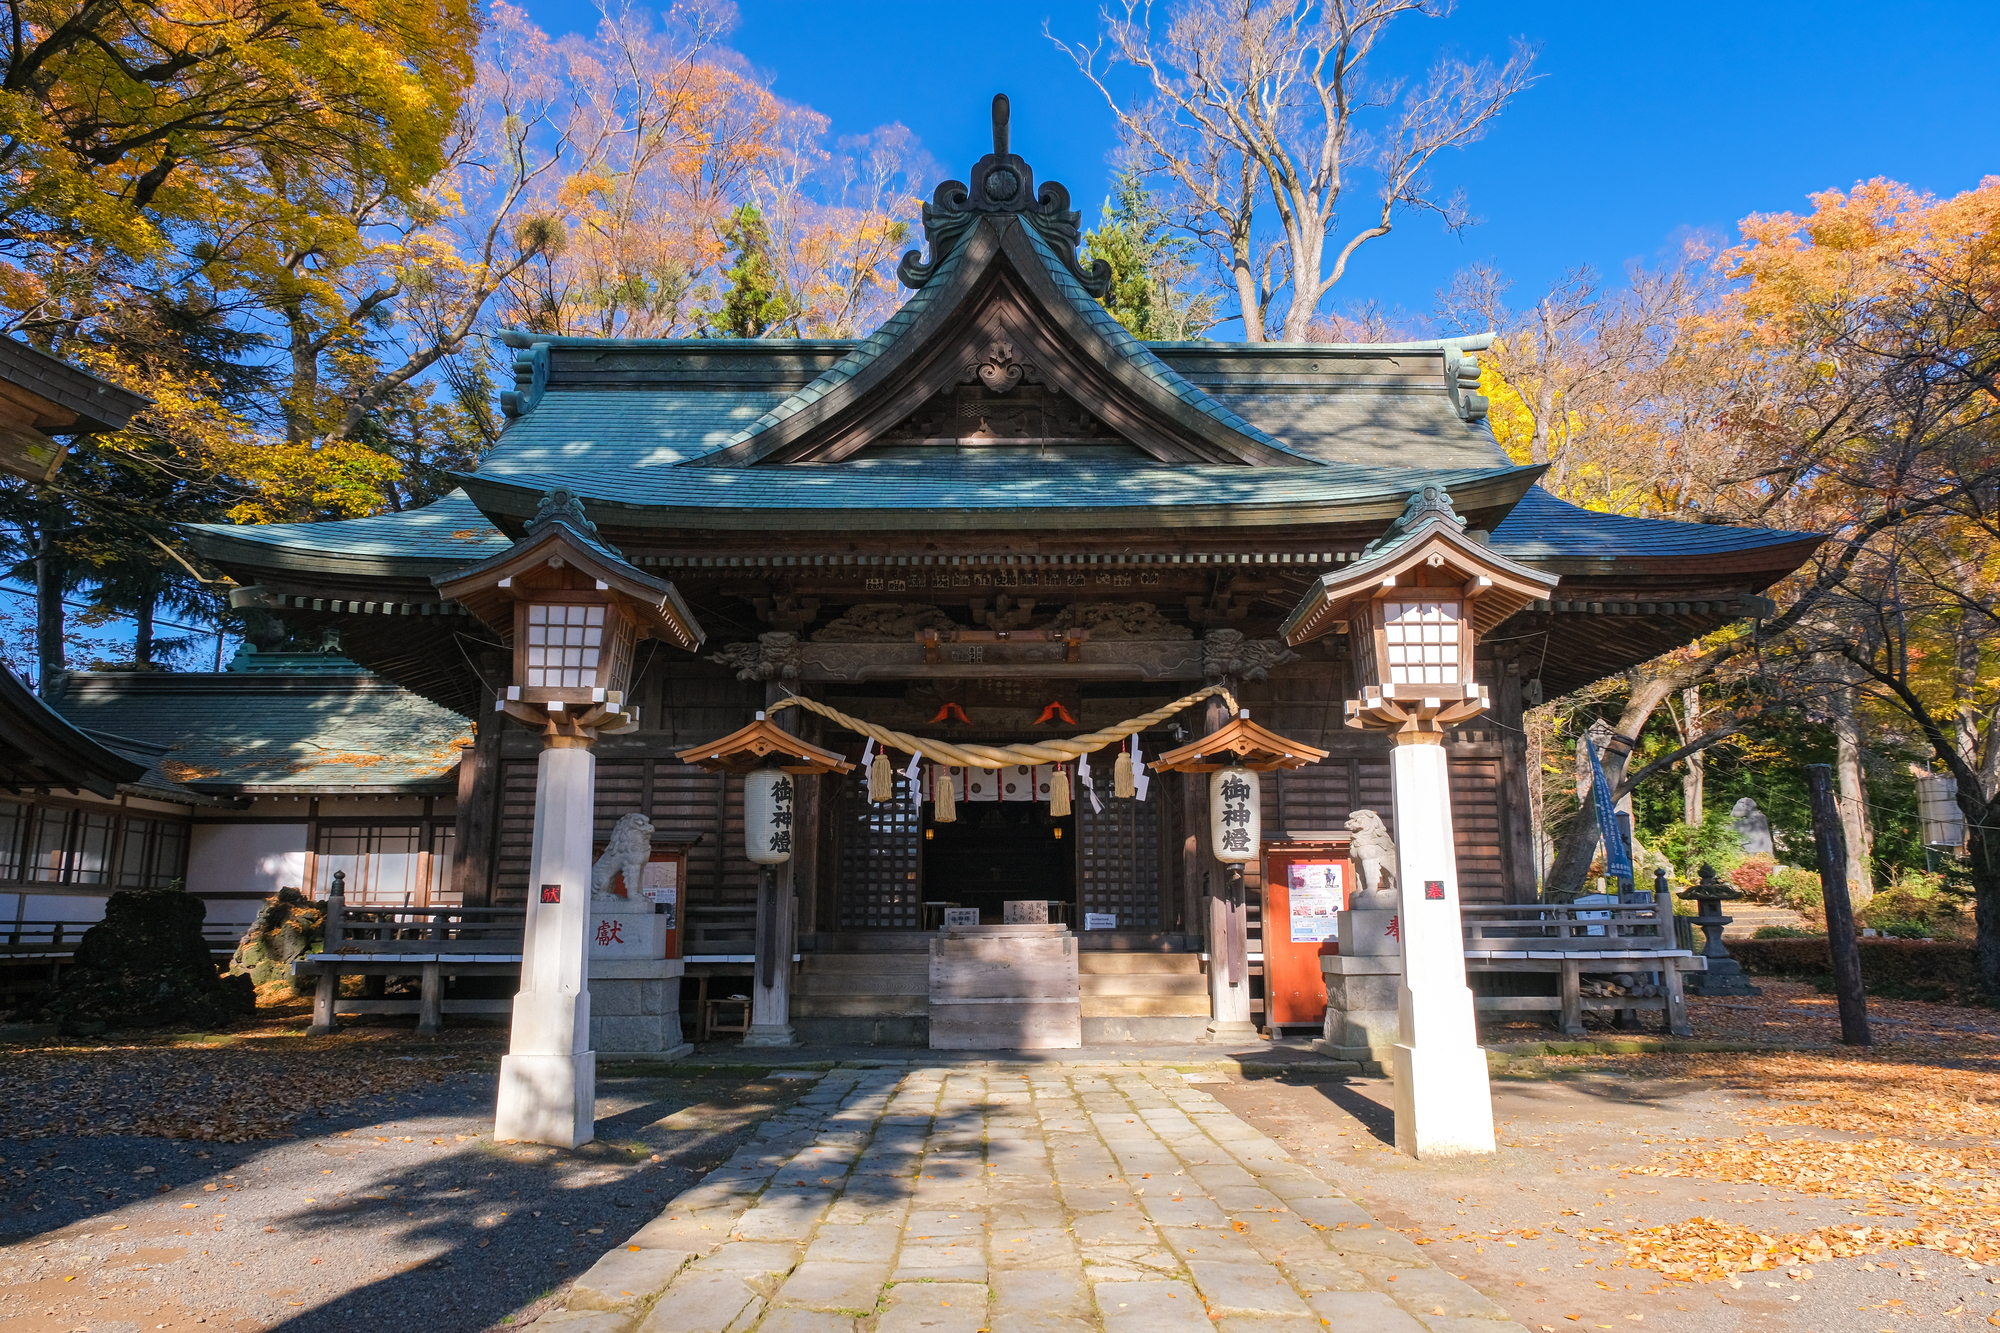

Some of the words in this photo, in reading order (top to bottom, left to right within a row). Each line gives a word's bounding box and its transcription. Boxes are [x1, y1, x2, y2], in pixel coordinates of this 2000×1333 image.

[769, 776, 793, 853] 御神燈
[1220, 774, 1251, 852] 御神燈
[1427, 882, 1444, 899] 奉
